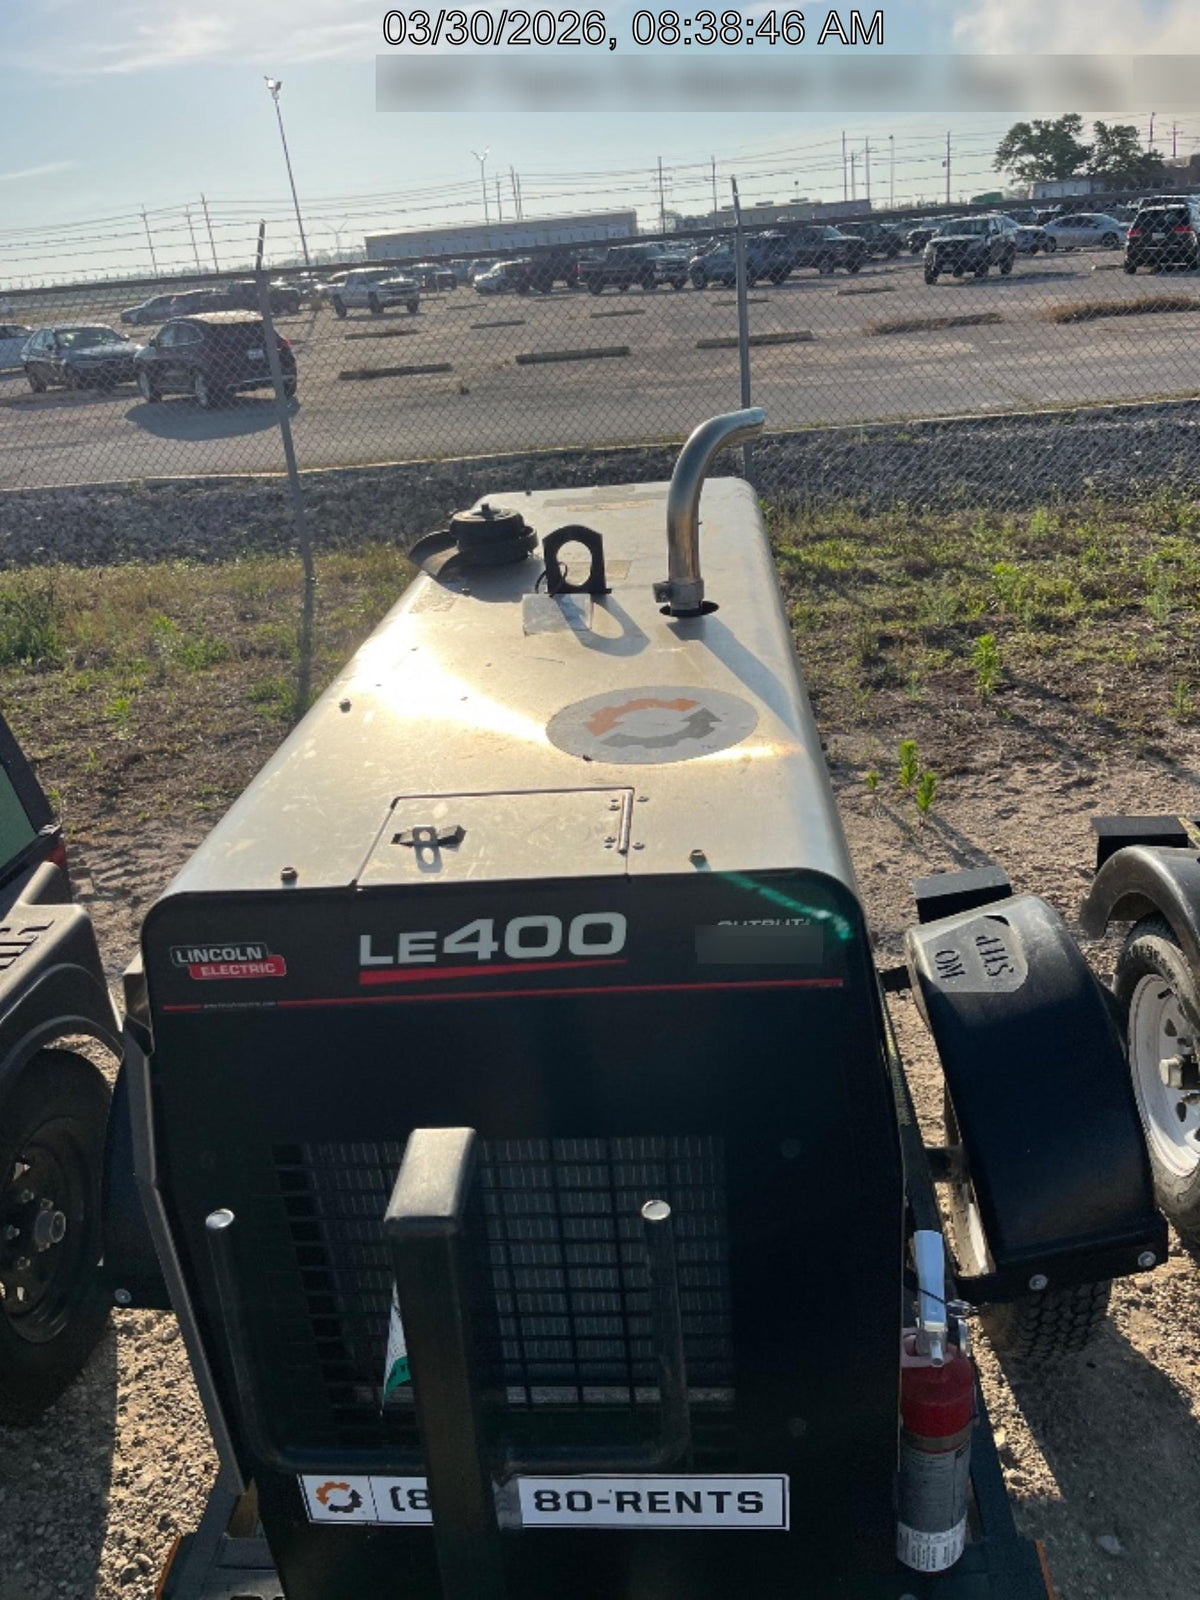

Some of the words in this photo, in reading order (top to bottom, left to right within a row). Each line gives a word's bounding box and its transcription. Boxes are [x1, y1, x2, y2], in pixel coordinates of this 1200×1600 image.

[359, 912, 627, 966] LE400
[176, 946, 263, 963] LINCOLN
[935, 950, 966, 979] NO
[200, 963, 276, 977] ELECTRIC
[533, 1489, 764, 1513] 80-RENTS
